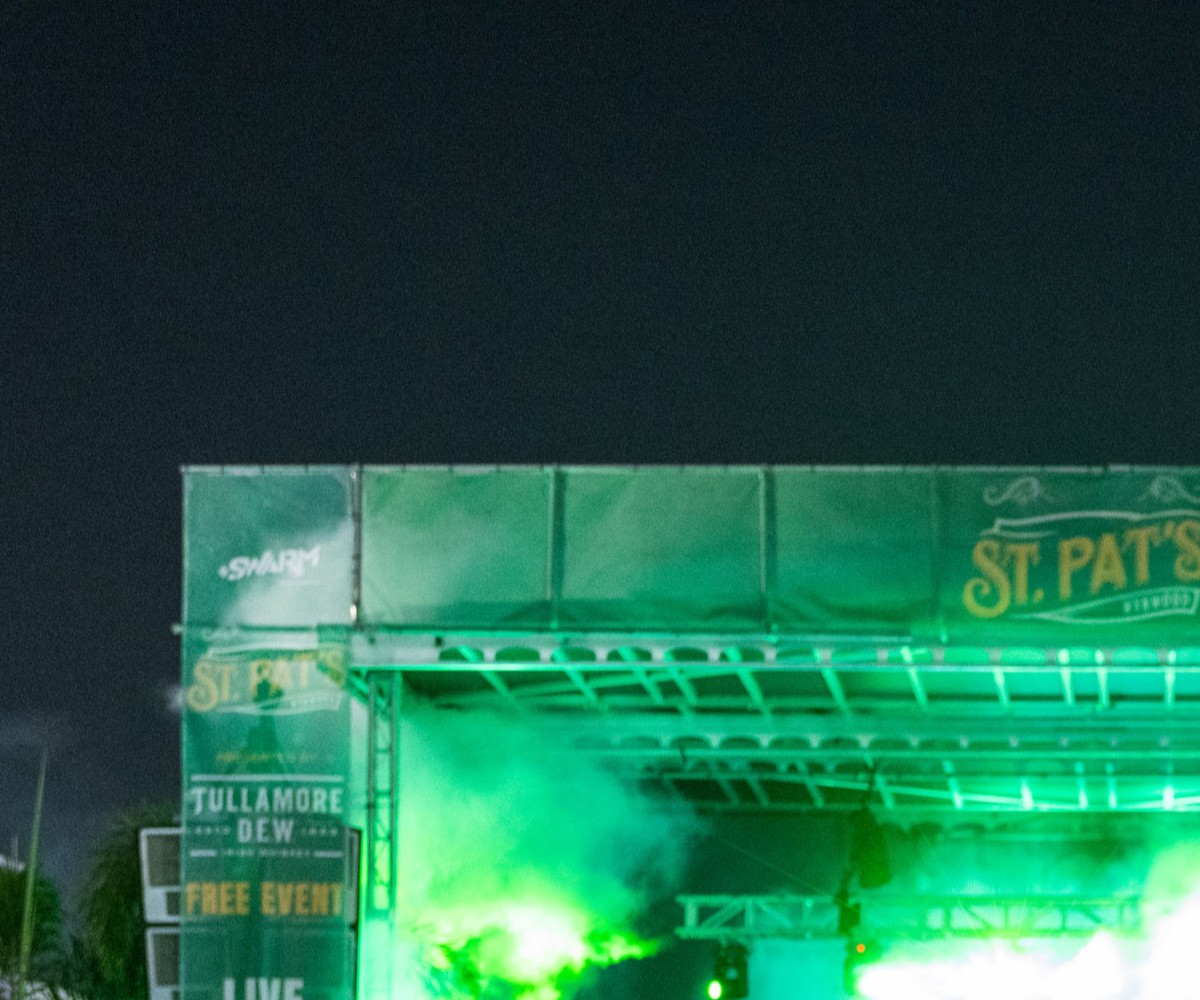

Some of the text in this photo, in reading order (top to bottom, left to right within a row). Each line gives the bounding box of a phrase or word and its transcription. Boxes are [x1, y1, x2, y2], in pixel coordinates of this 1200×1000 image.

[962, 539, 1044, 618] ST.
[190, 786, 343, 815] TULLAMORE
[237, 817, 294, 843] DEW
[186, 881, 342, 916] FREE EVENT
